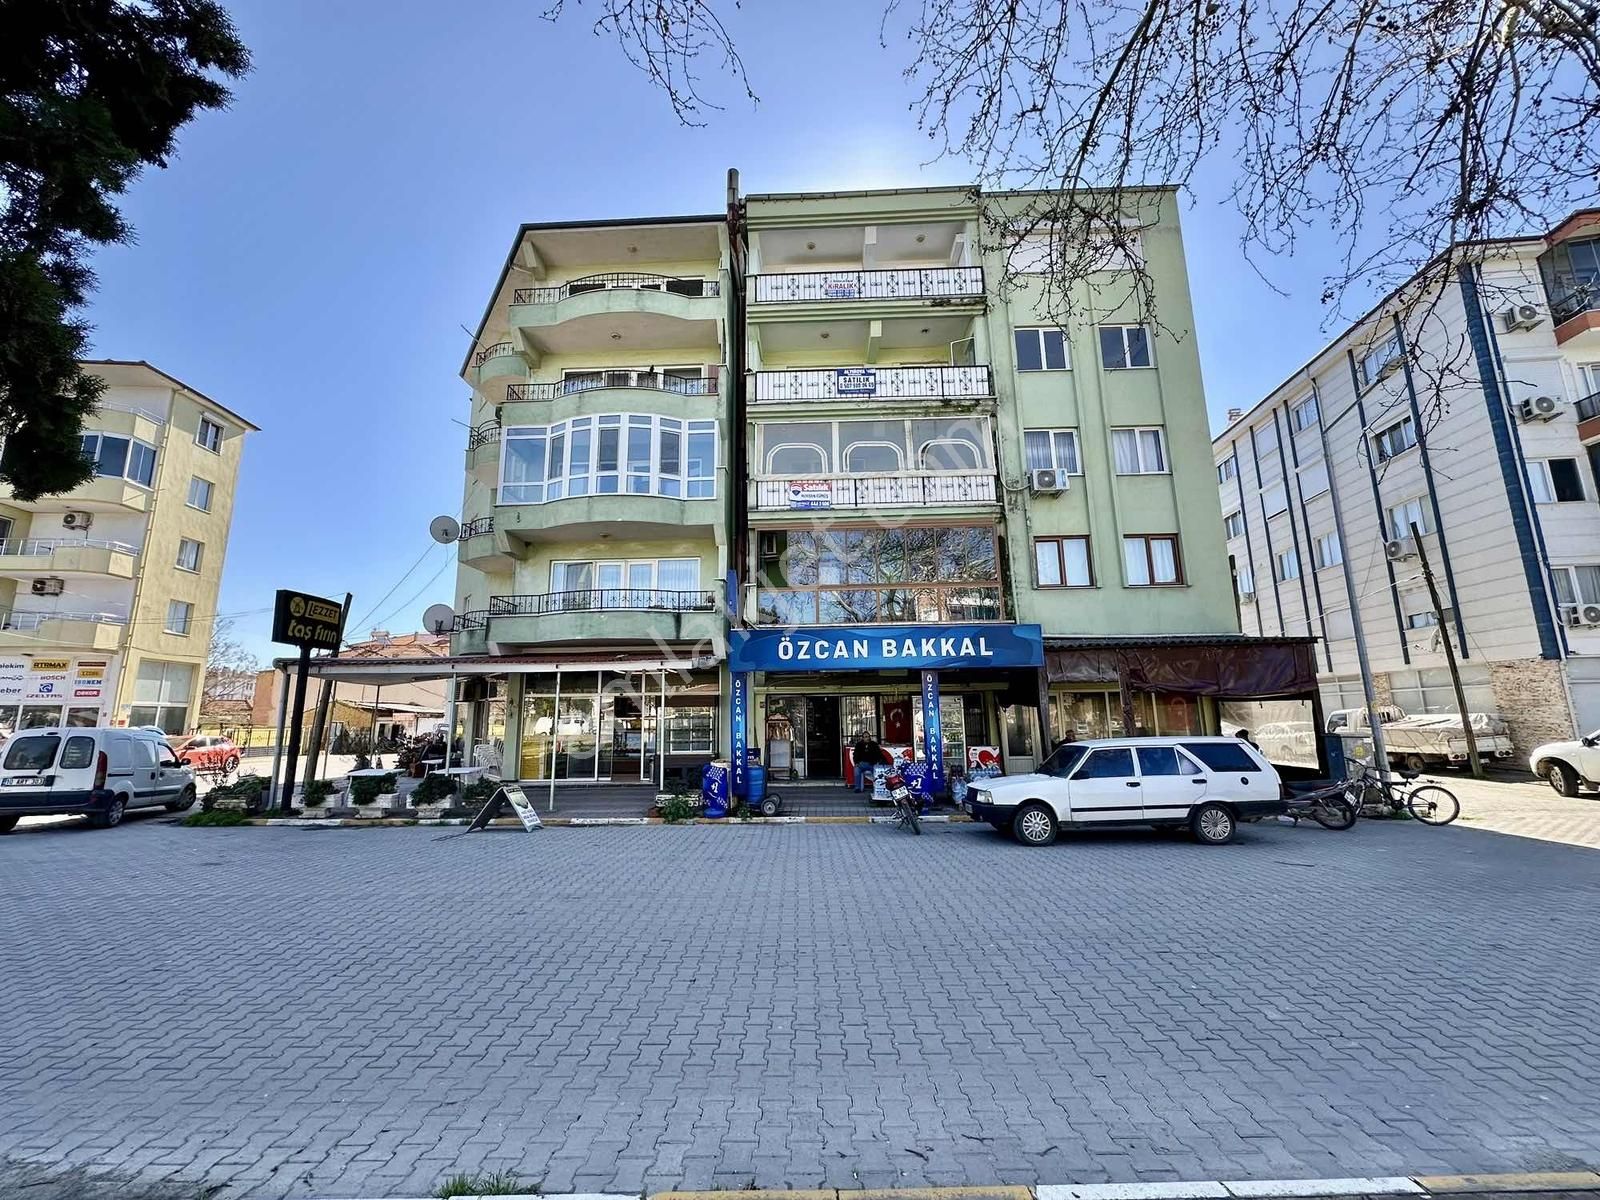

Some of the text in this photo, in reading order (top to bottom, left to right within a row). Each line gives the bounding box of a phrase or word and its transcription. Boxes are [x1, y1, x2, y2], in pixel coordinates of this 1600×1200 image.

[308, 602, 338, 620] LEZZET
[288, 620, 337, 643] taş fırın
[777, 636, 994, 660] ÖZCAN BAKKAL
[926, 674, 939, 780] ÖZCAN BAKKAL
